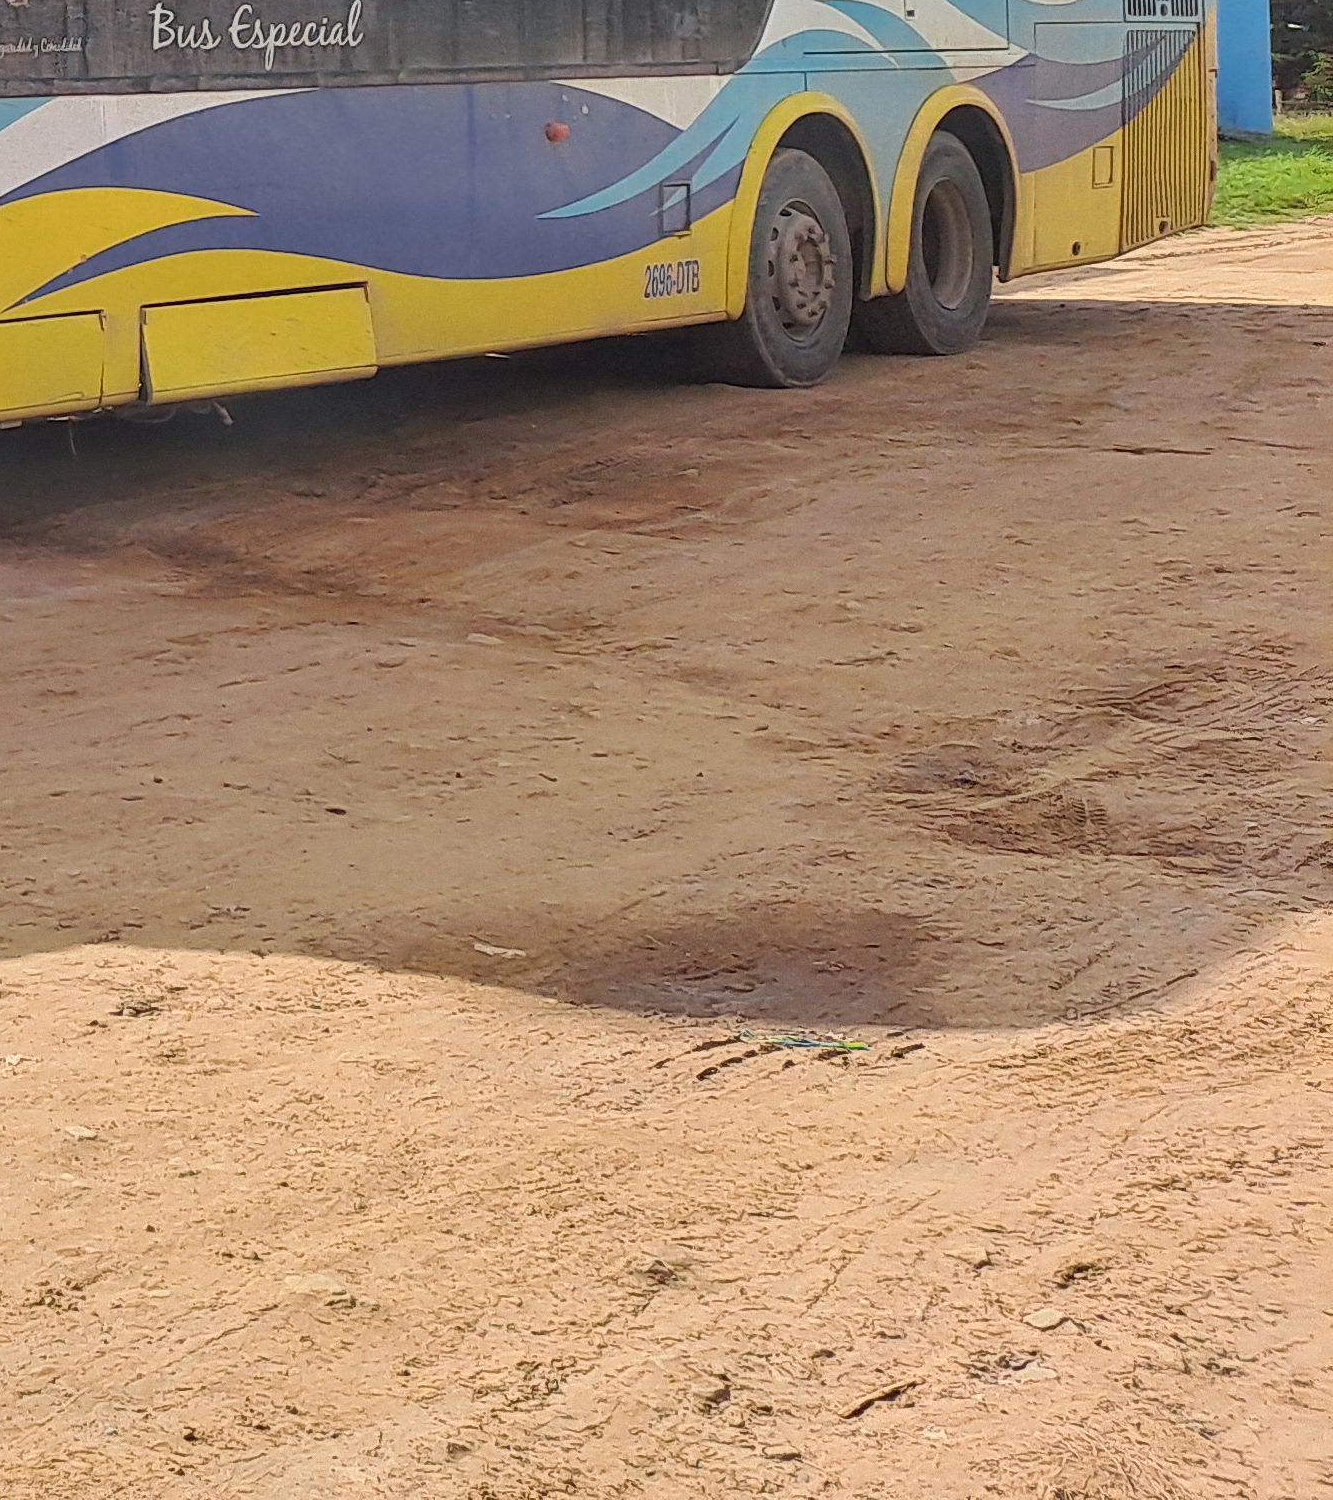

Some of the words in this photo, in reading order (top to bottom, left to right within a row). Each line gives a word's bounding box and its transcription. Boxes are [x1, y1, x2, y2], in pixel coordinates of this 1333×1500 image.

[148, 2, 222, 51] Bus
[228, 0, 364, 72] Especial
[644, 259, 701, 299] 2696-DTB
